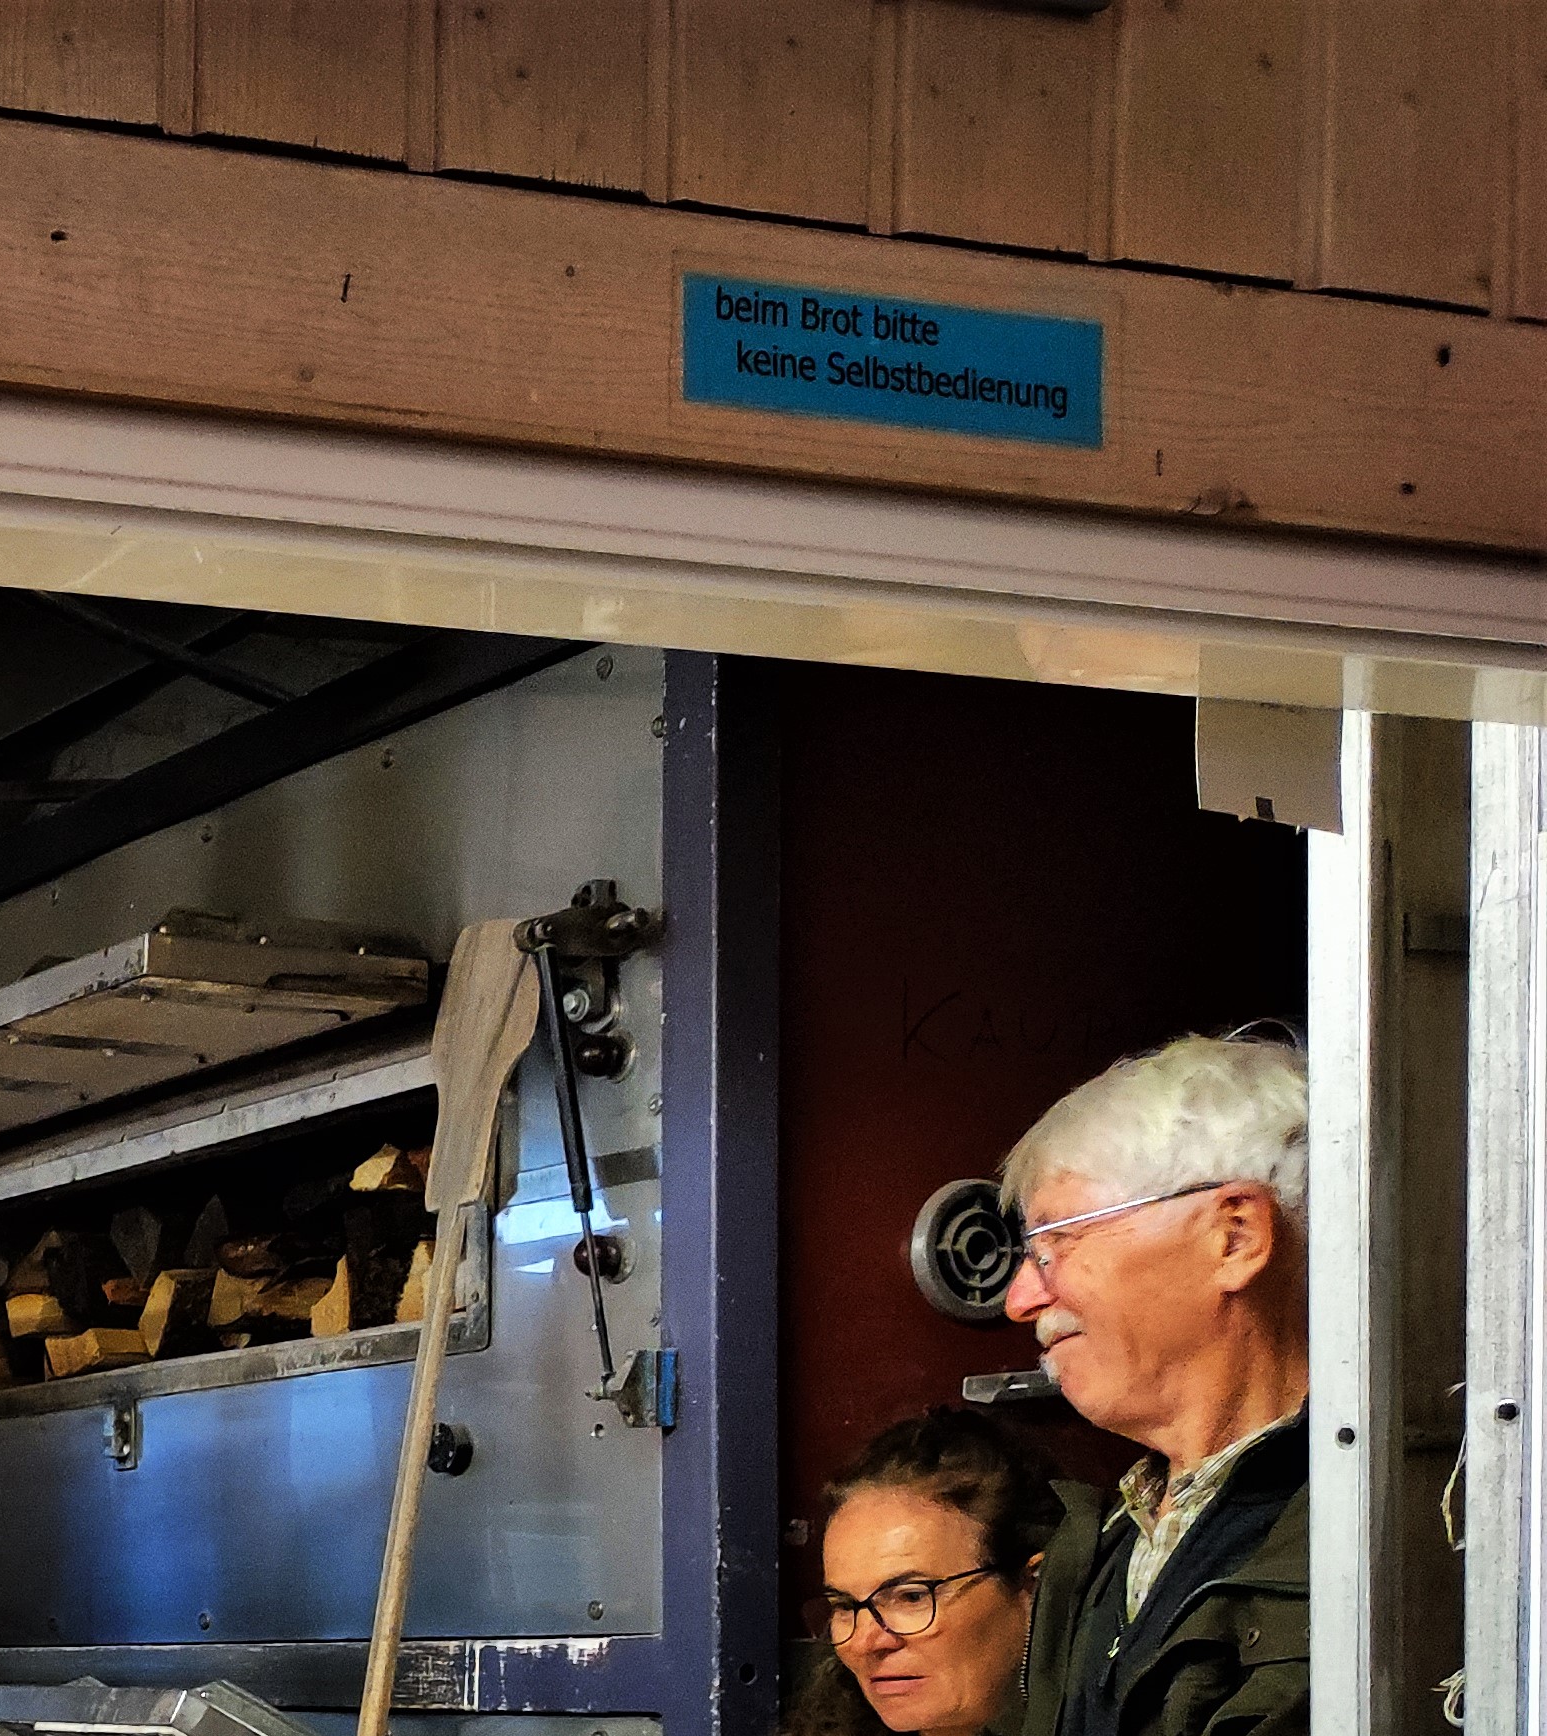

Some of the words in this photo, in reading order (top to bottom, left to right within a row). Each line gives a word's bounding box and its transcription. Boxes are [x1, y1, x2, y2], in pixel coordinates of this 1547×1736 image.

[715, 286, 788, 327] beim
[801, 297, 863, 338] Brot
[873, 305, 940, 347] bitte
[735, 341, 817, 380] keine
[826, 351, 1069, 418] Selbstbedienung
